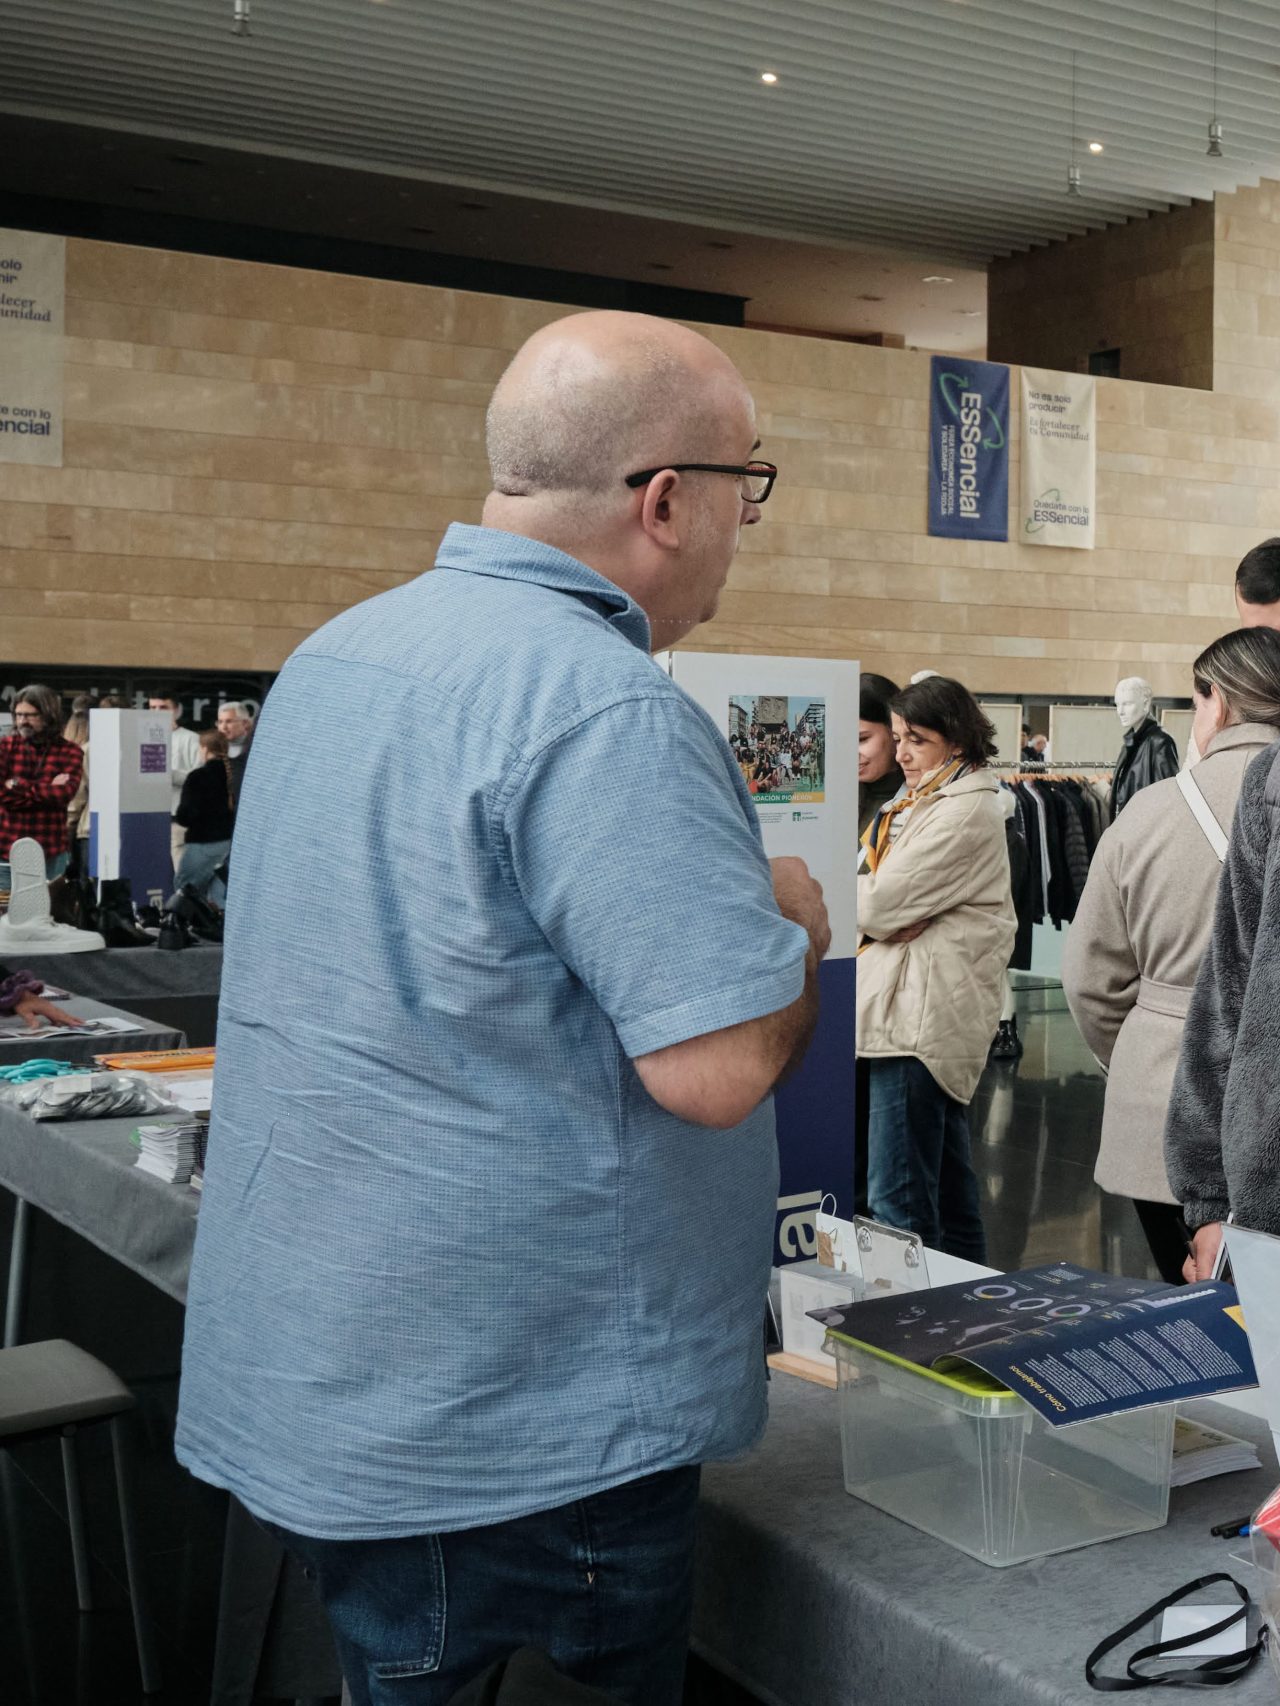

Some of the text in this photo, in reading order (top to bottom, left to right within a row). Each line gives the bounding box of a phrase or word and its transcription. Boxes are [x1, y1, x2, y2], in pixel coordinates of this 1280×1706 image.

[0, 259, 22, 271] olo
[0, 293, 36, 308] lecer
[1028, 391, 1072, 403] No es solo
[12, 406, 37, 418] con
[40, 408, 52, 420] lo
[1028, 402, 1066, 413] producir
[1039, 418, 1080, 431] fortalecer
[959, 391, 982, 519] ESSencial
[1034, 510, 1089, 526] ESSencial
[782, 794, 812, 802] PIONEROS
